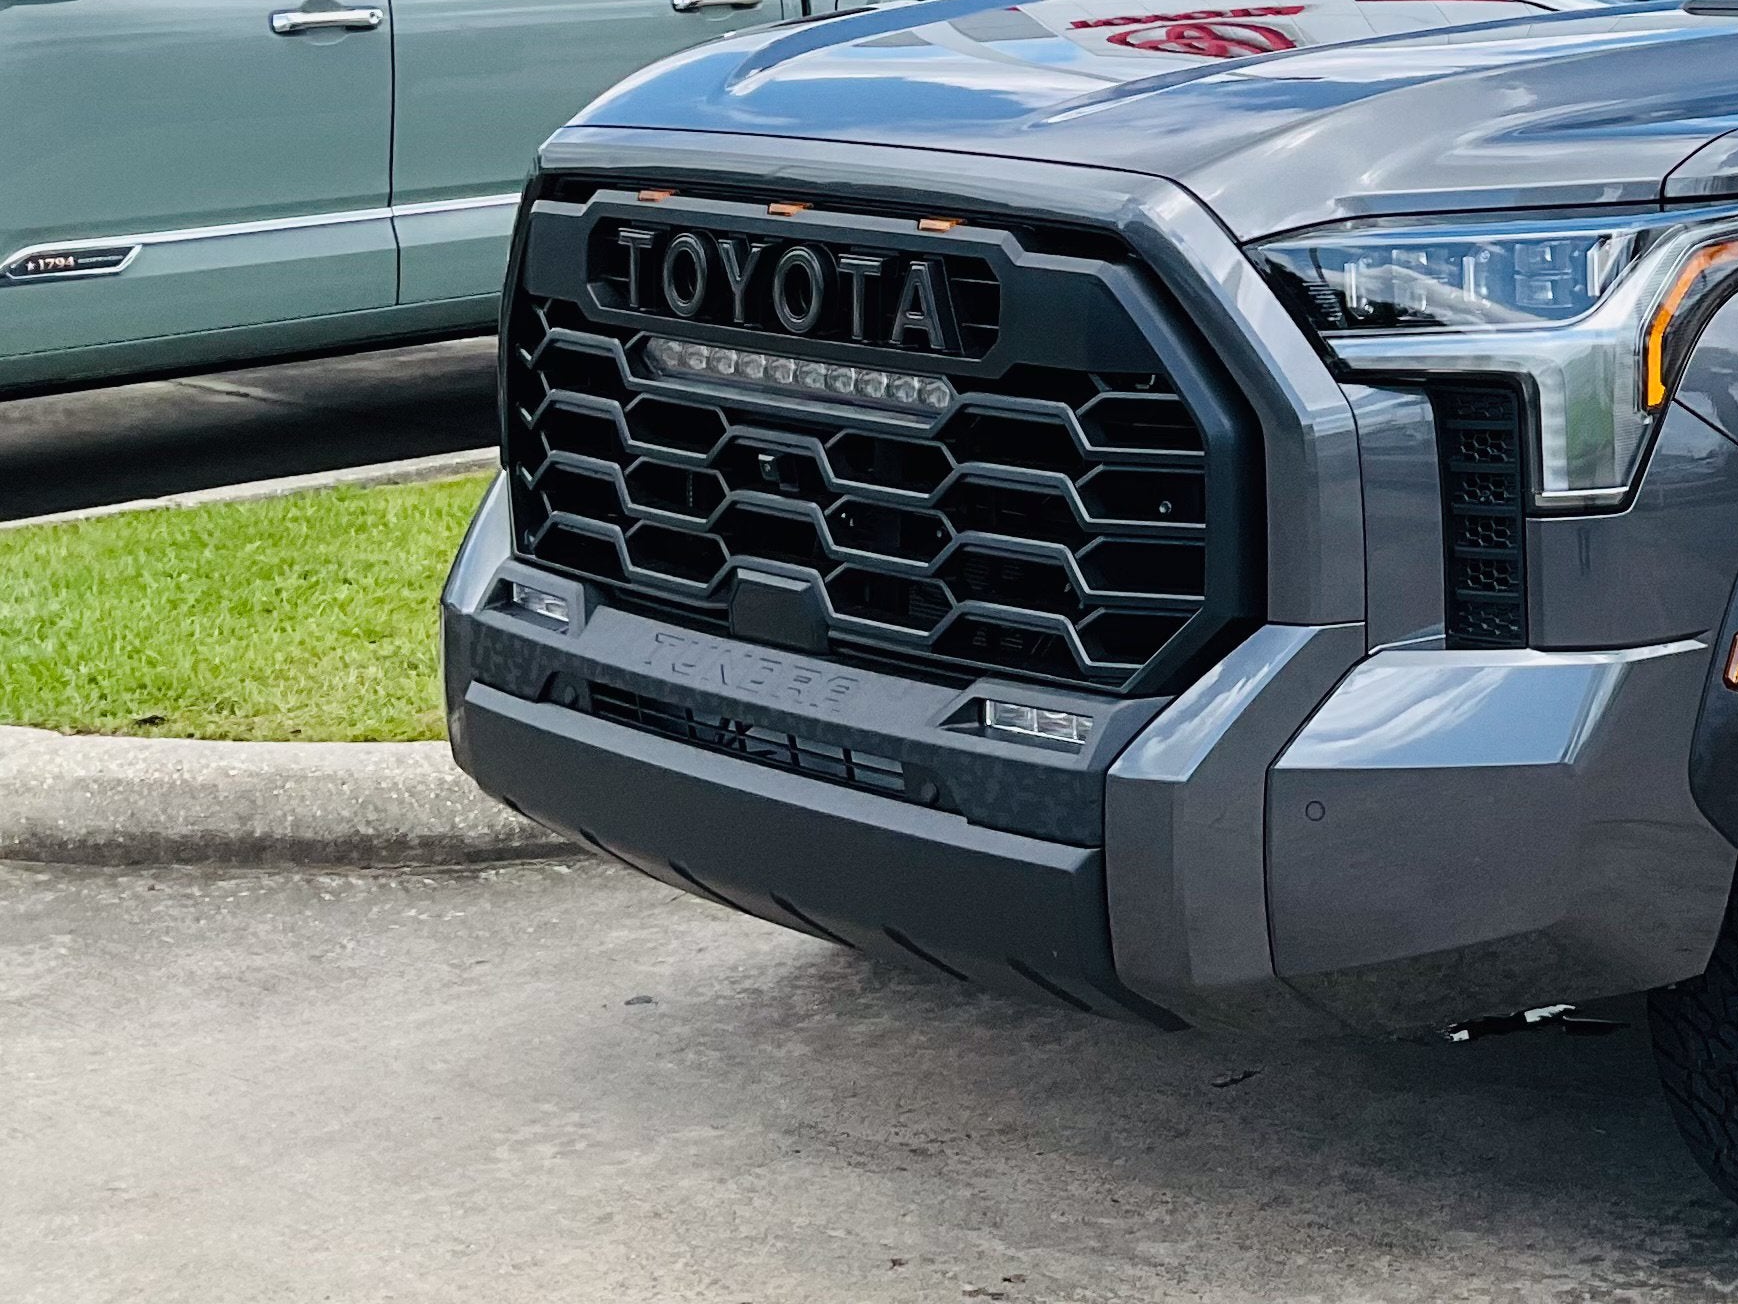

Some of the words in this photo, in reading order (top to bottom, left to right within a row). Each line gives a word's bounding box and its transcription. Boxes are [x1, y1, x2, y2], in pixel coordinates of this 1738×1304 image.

[38, 256, 75, 271] 1794
[618, 226, 955, 353] TOYOTA
[644, 632, 860, 713] TUNDRA
